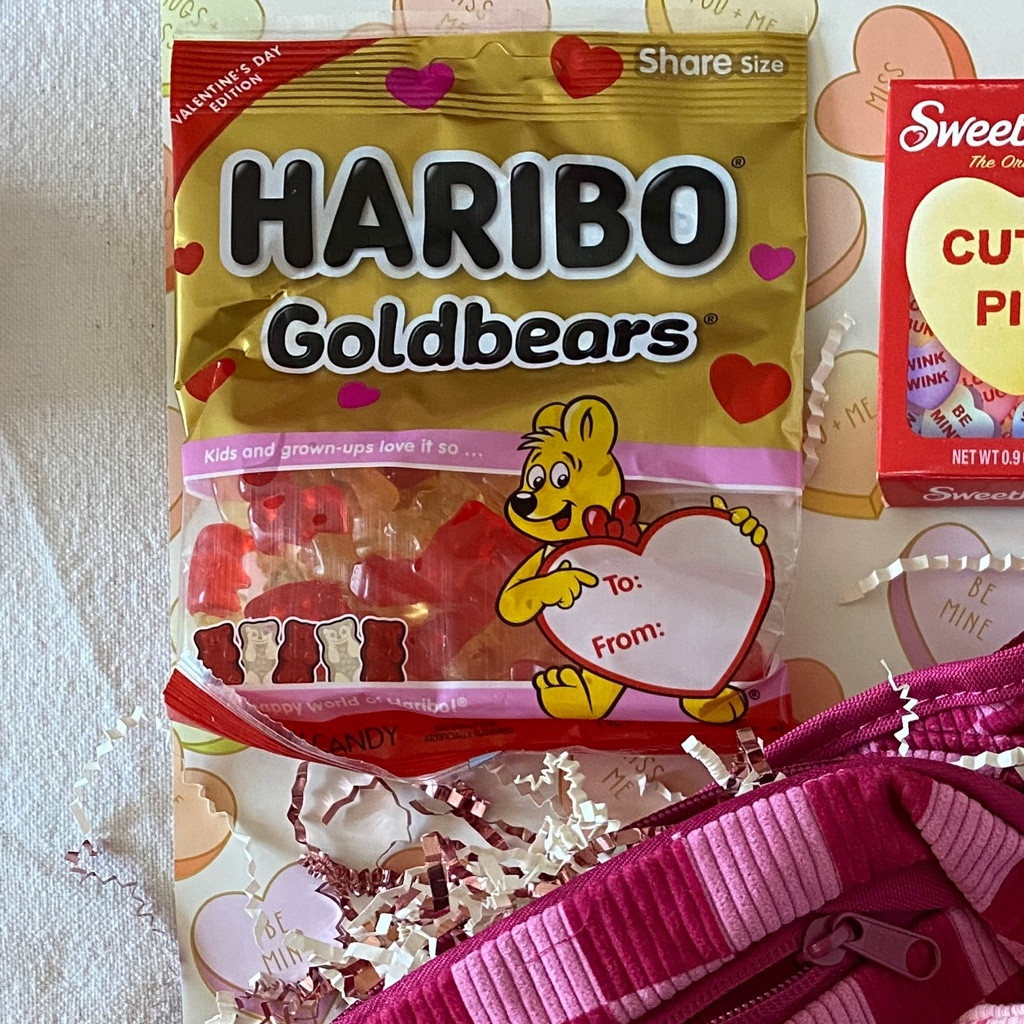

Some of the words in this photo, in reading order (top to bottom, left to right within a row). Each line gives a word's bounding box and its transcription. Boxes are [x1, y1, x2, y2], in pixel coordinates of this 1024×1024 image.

[638, 46, 732, 76] Share
[741, 55, 785, 74] Size
[170, 63, 251, 124] VALENTINE'S
[252, 45, 282, 68] DAY
[209, 73, 263, 113] EDITION
[969, 154, 996, 169] The
[230, 156, 729, 270] HARIBO
[266, 301, 694, 368] Goldbears
[907, 370, 950, 391] WINK
[845, 397, 877, 428] ME
[952, 404, 973, 428] BE
[204, 446, 238, 464] Kids
[242, 442, 275, 459] and
[281, 442, 374, 461] grown-ups
[379, 439, 415, 454] love
[421, 438, 434, 454] it
[438, 441, 459, 455] so
[952, 449, 976, 465] NET
[979, 449, 999, 465] WT
[1001, 449, 1020, 465] 0.9
[602, 574, 642, 596] To:
[967, 576, 997, 606] BE
[939, 598, 993, 641] MINE
[591, 622, 665, 659] From:
[265, 911, 290, 939] BE
[262, 946, 303, 975] MIN
